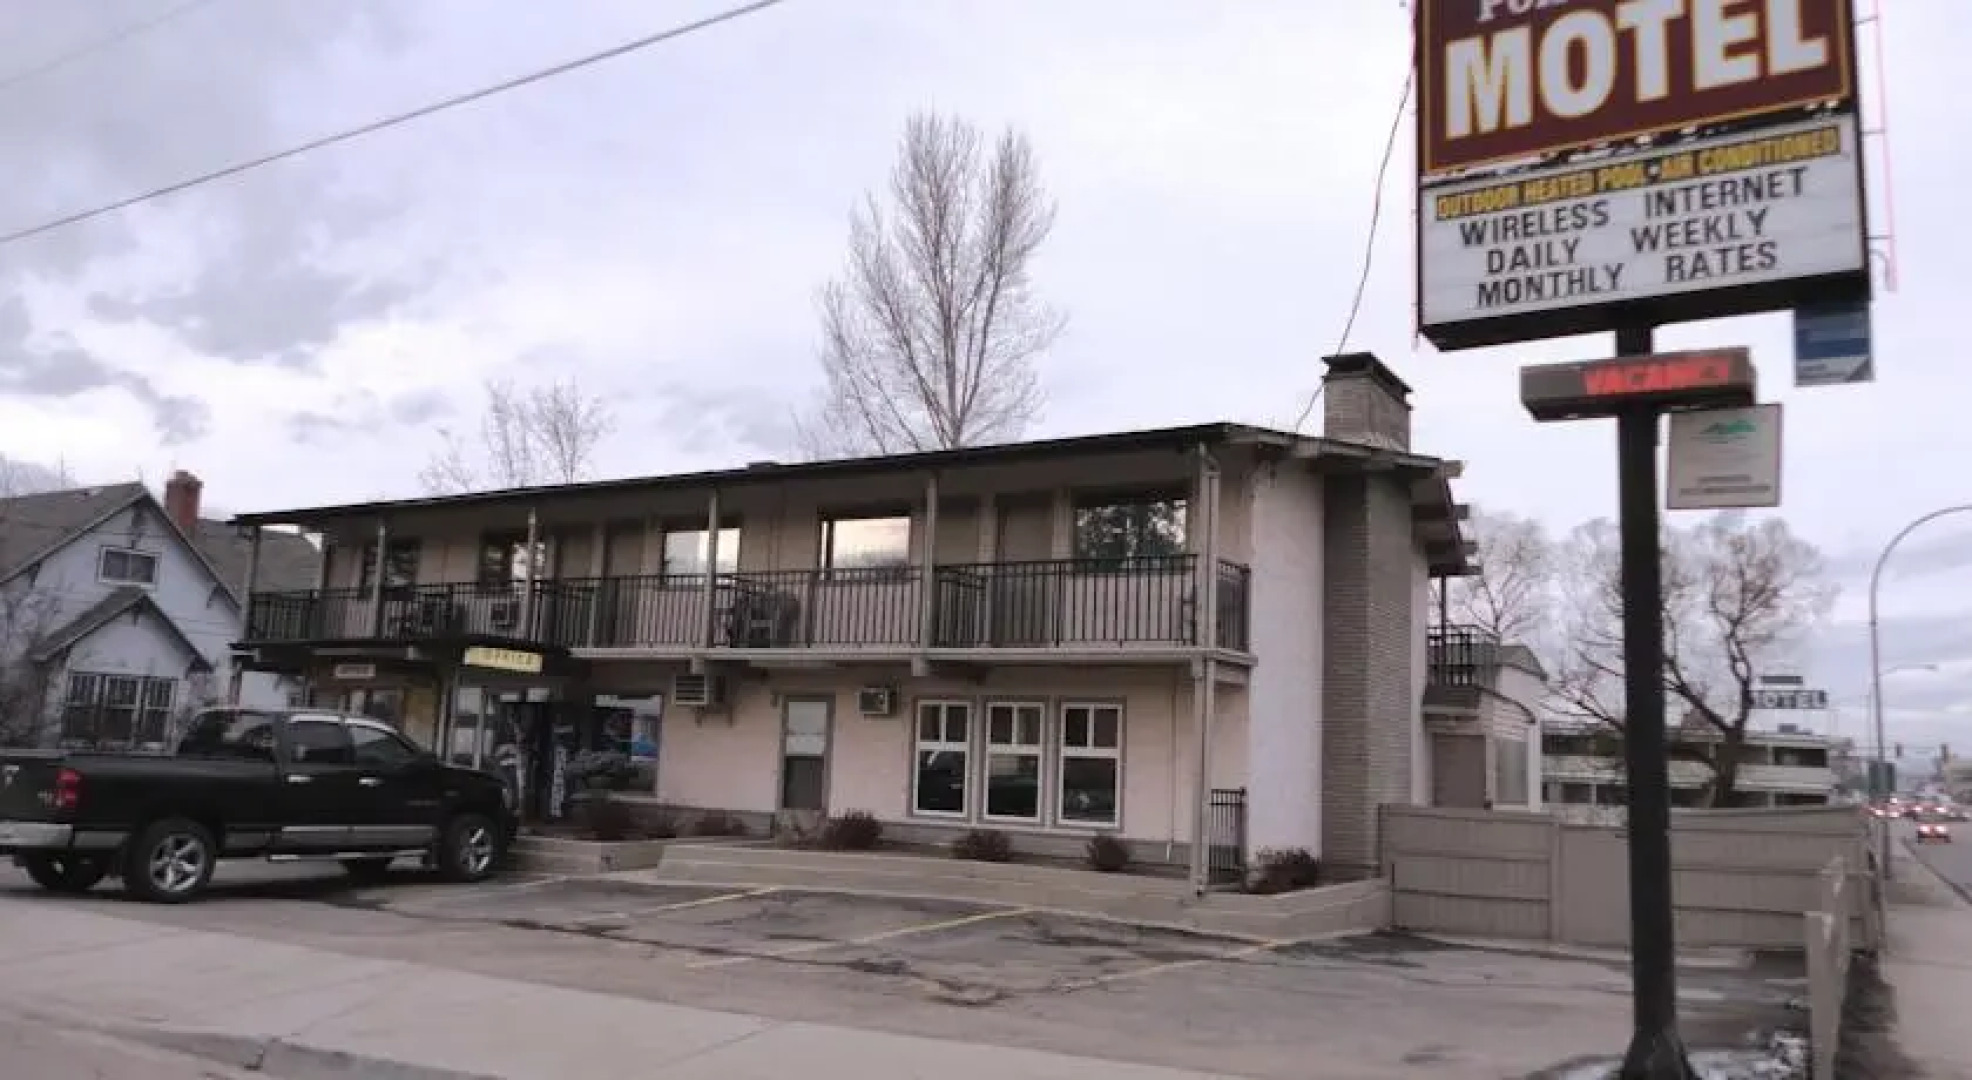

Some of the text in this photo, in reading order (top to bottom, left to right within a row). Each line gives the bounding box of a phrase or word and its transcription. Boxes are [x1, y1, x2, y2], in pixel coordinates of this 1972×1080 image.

[1445, 0, 1829, 140] MOTEL
[1438, 128, 1839, 217] OUTDOOR HEATED POOL AIR CONDITIONED
[1460, 168, 1807, 246] WIRELESS INTERNET
[1477, 241, 1778, 308] MONTHLY RATES
[1487, 207, 1769, 275] DAILY WEEKLY
